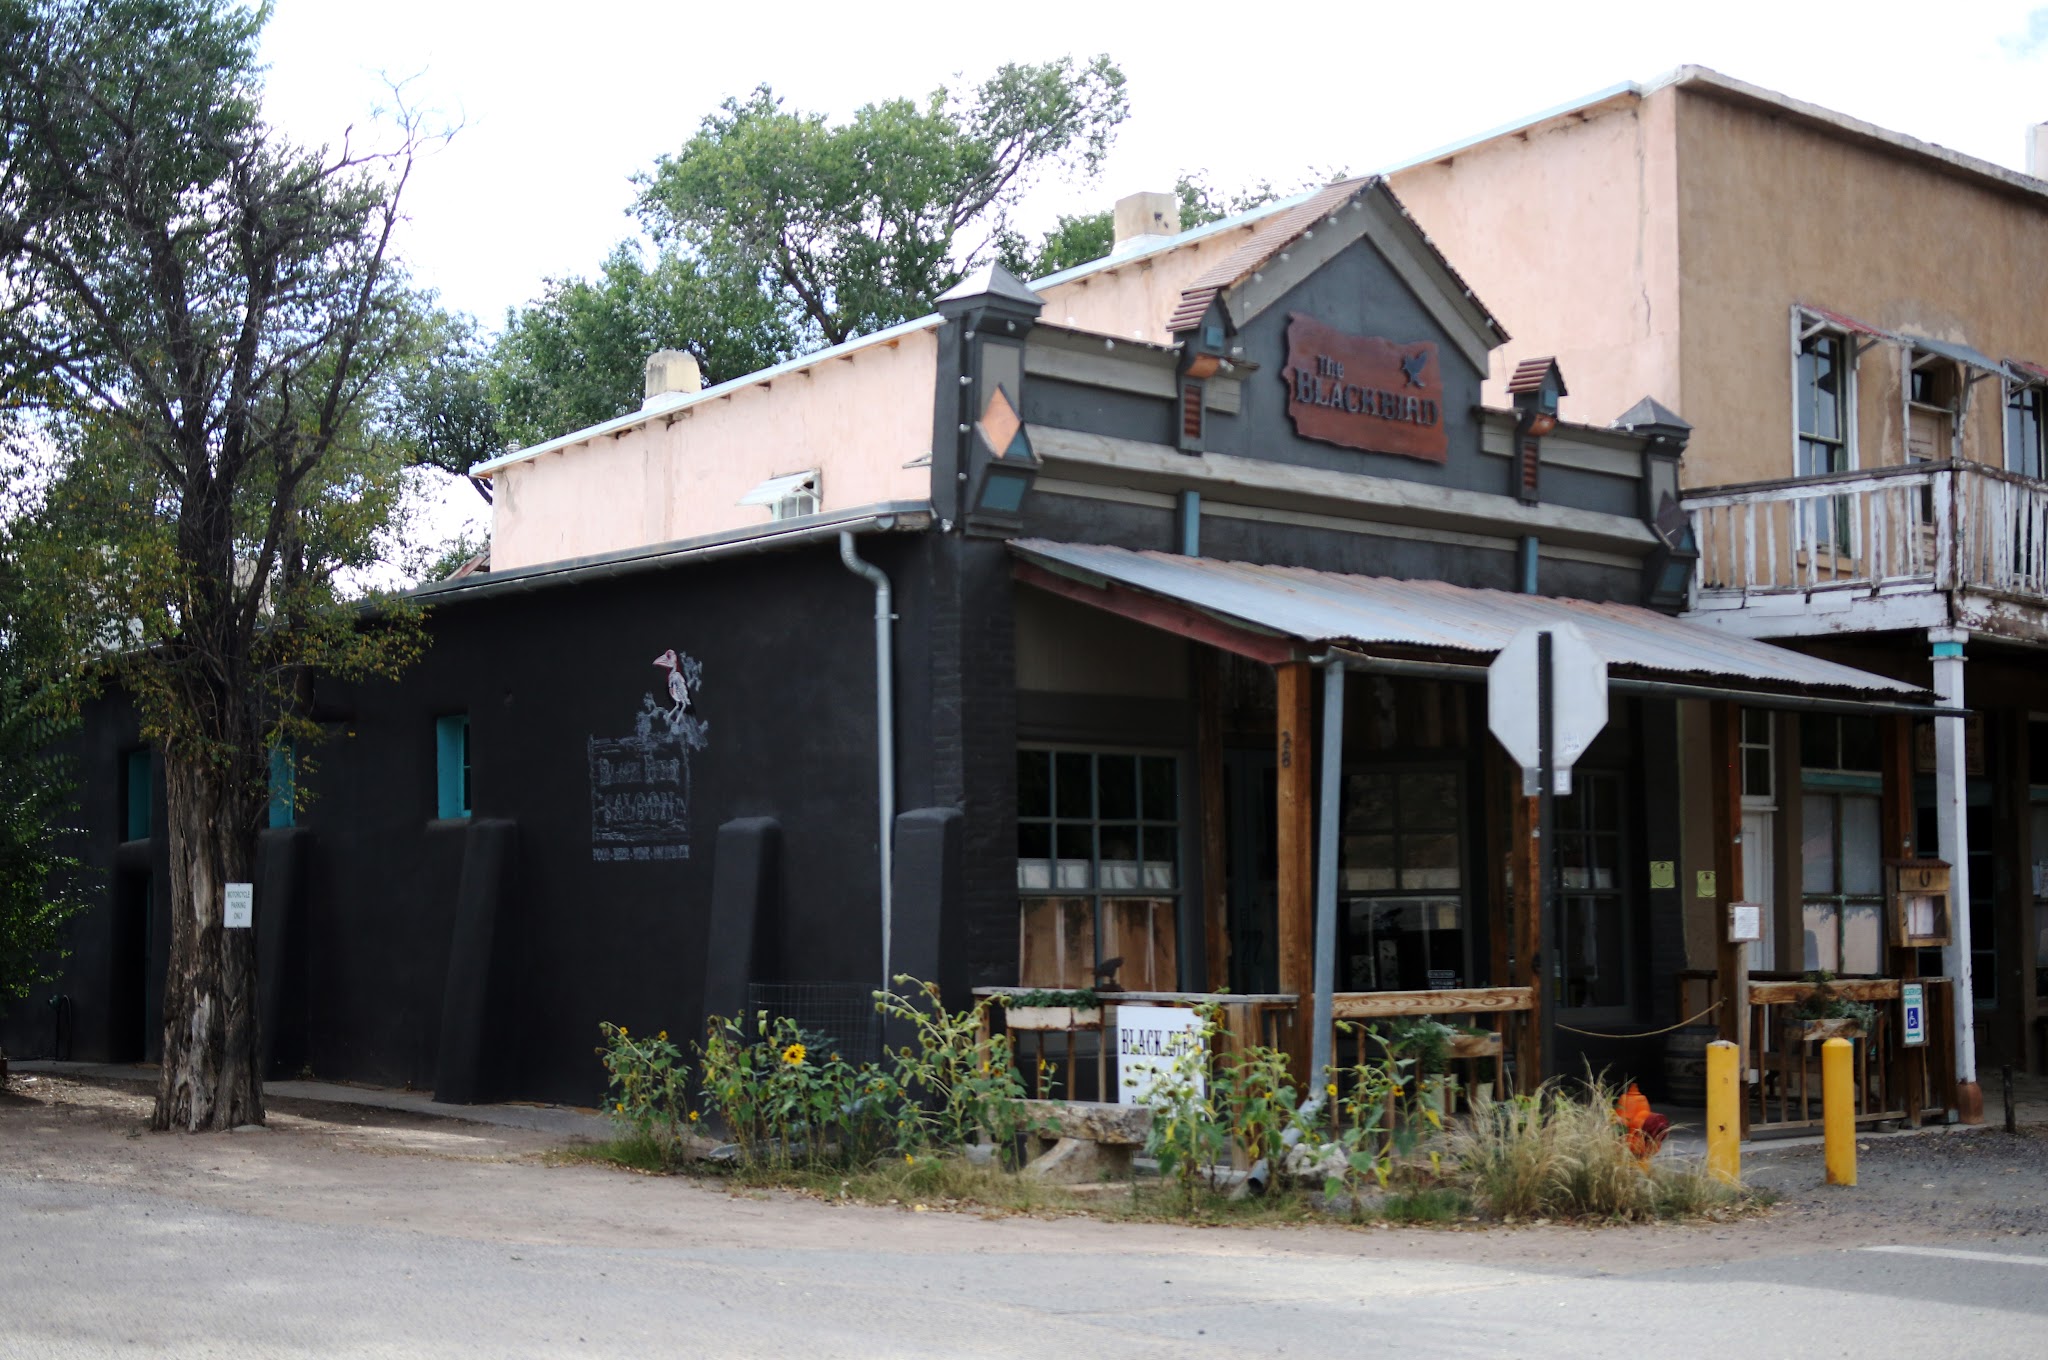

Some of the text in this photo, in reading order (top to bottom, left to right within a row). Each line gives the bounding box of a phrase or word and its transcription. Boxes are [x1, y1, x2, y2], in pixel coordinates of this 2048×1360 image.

[1317, 353, 1345, 378] The
[1294, 367, 1438, 426] BLACKBIRD
[227, 891, 250, 899] MOTORCYCLE
[231, 901, 246, 909] PARKING
[1121, 1028, 1163, 1056] BLACK
